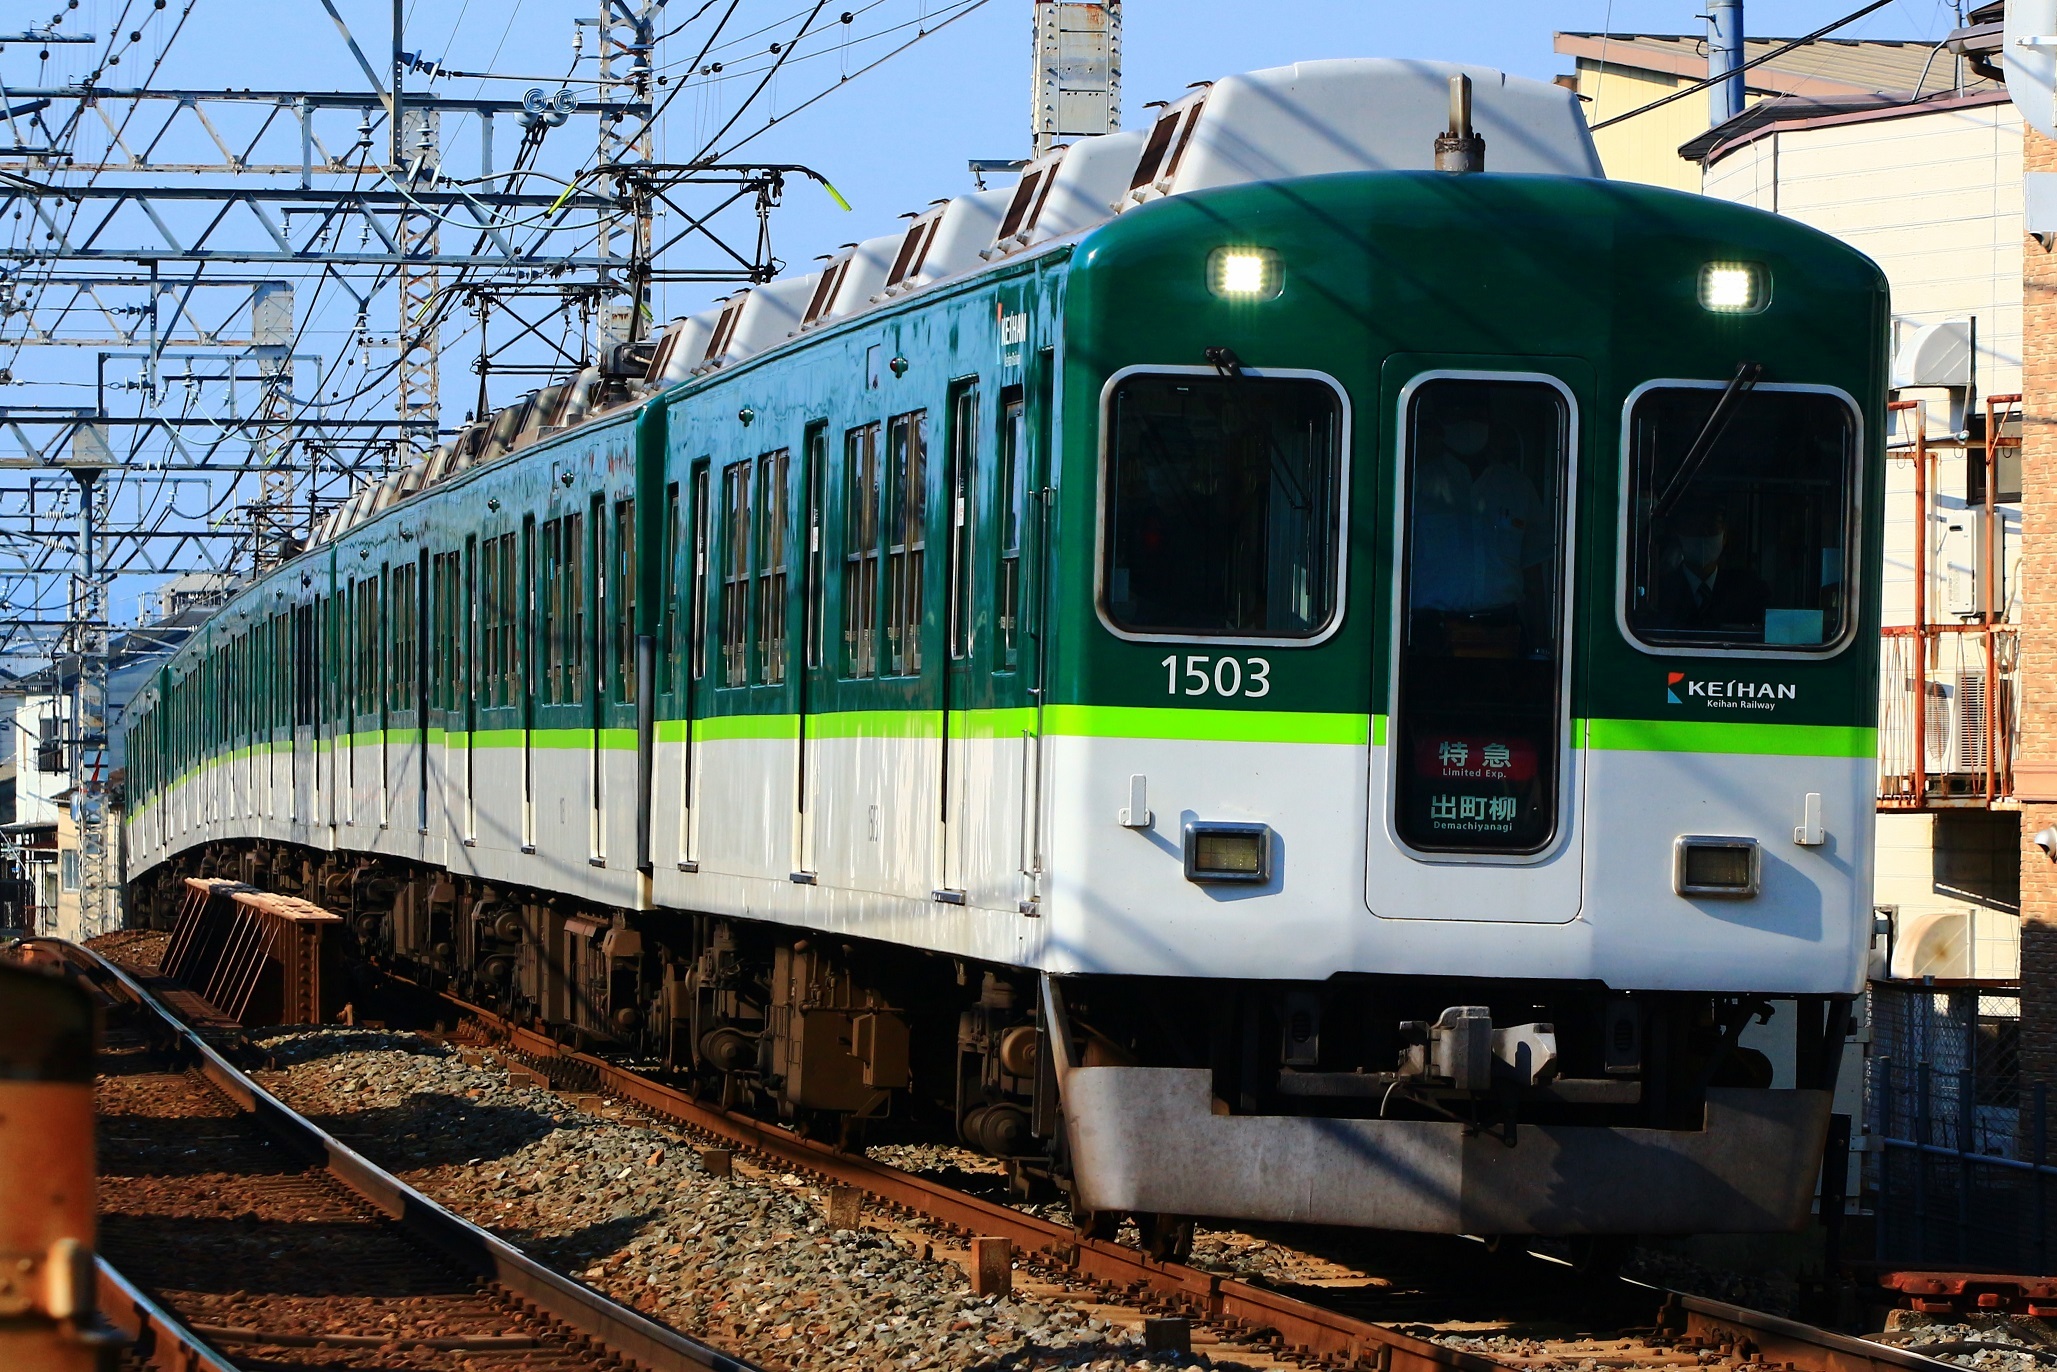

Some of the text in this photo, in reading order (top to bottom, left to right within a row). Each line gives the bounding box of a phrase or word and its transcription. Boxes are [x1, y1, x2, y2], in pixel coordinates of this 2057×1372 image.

[1001, 311, 1026, 347] KEIHAN
[1161, 655, 1270, 698] 1503
[1688, 680, 1796, 699] KEIHAN
[1707, 699, 1775, 711] Keihan Railway
[1438, 741, 1511, 768] 特急
[1442, 768, 1507, 779] Limited Exp.
[1430, 794, 1517, 821] 出町柳
[1434, 821, 1513, 833] Demachiyanagi
